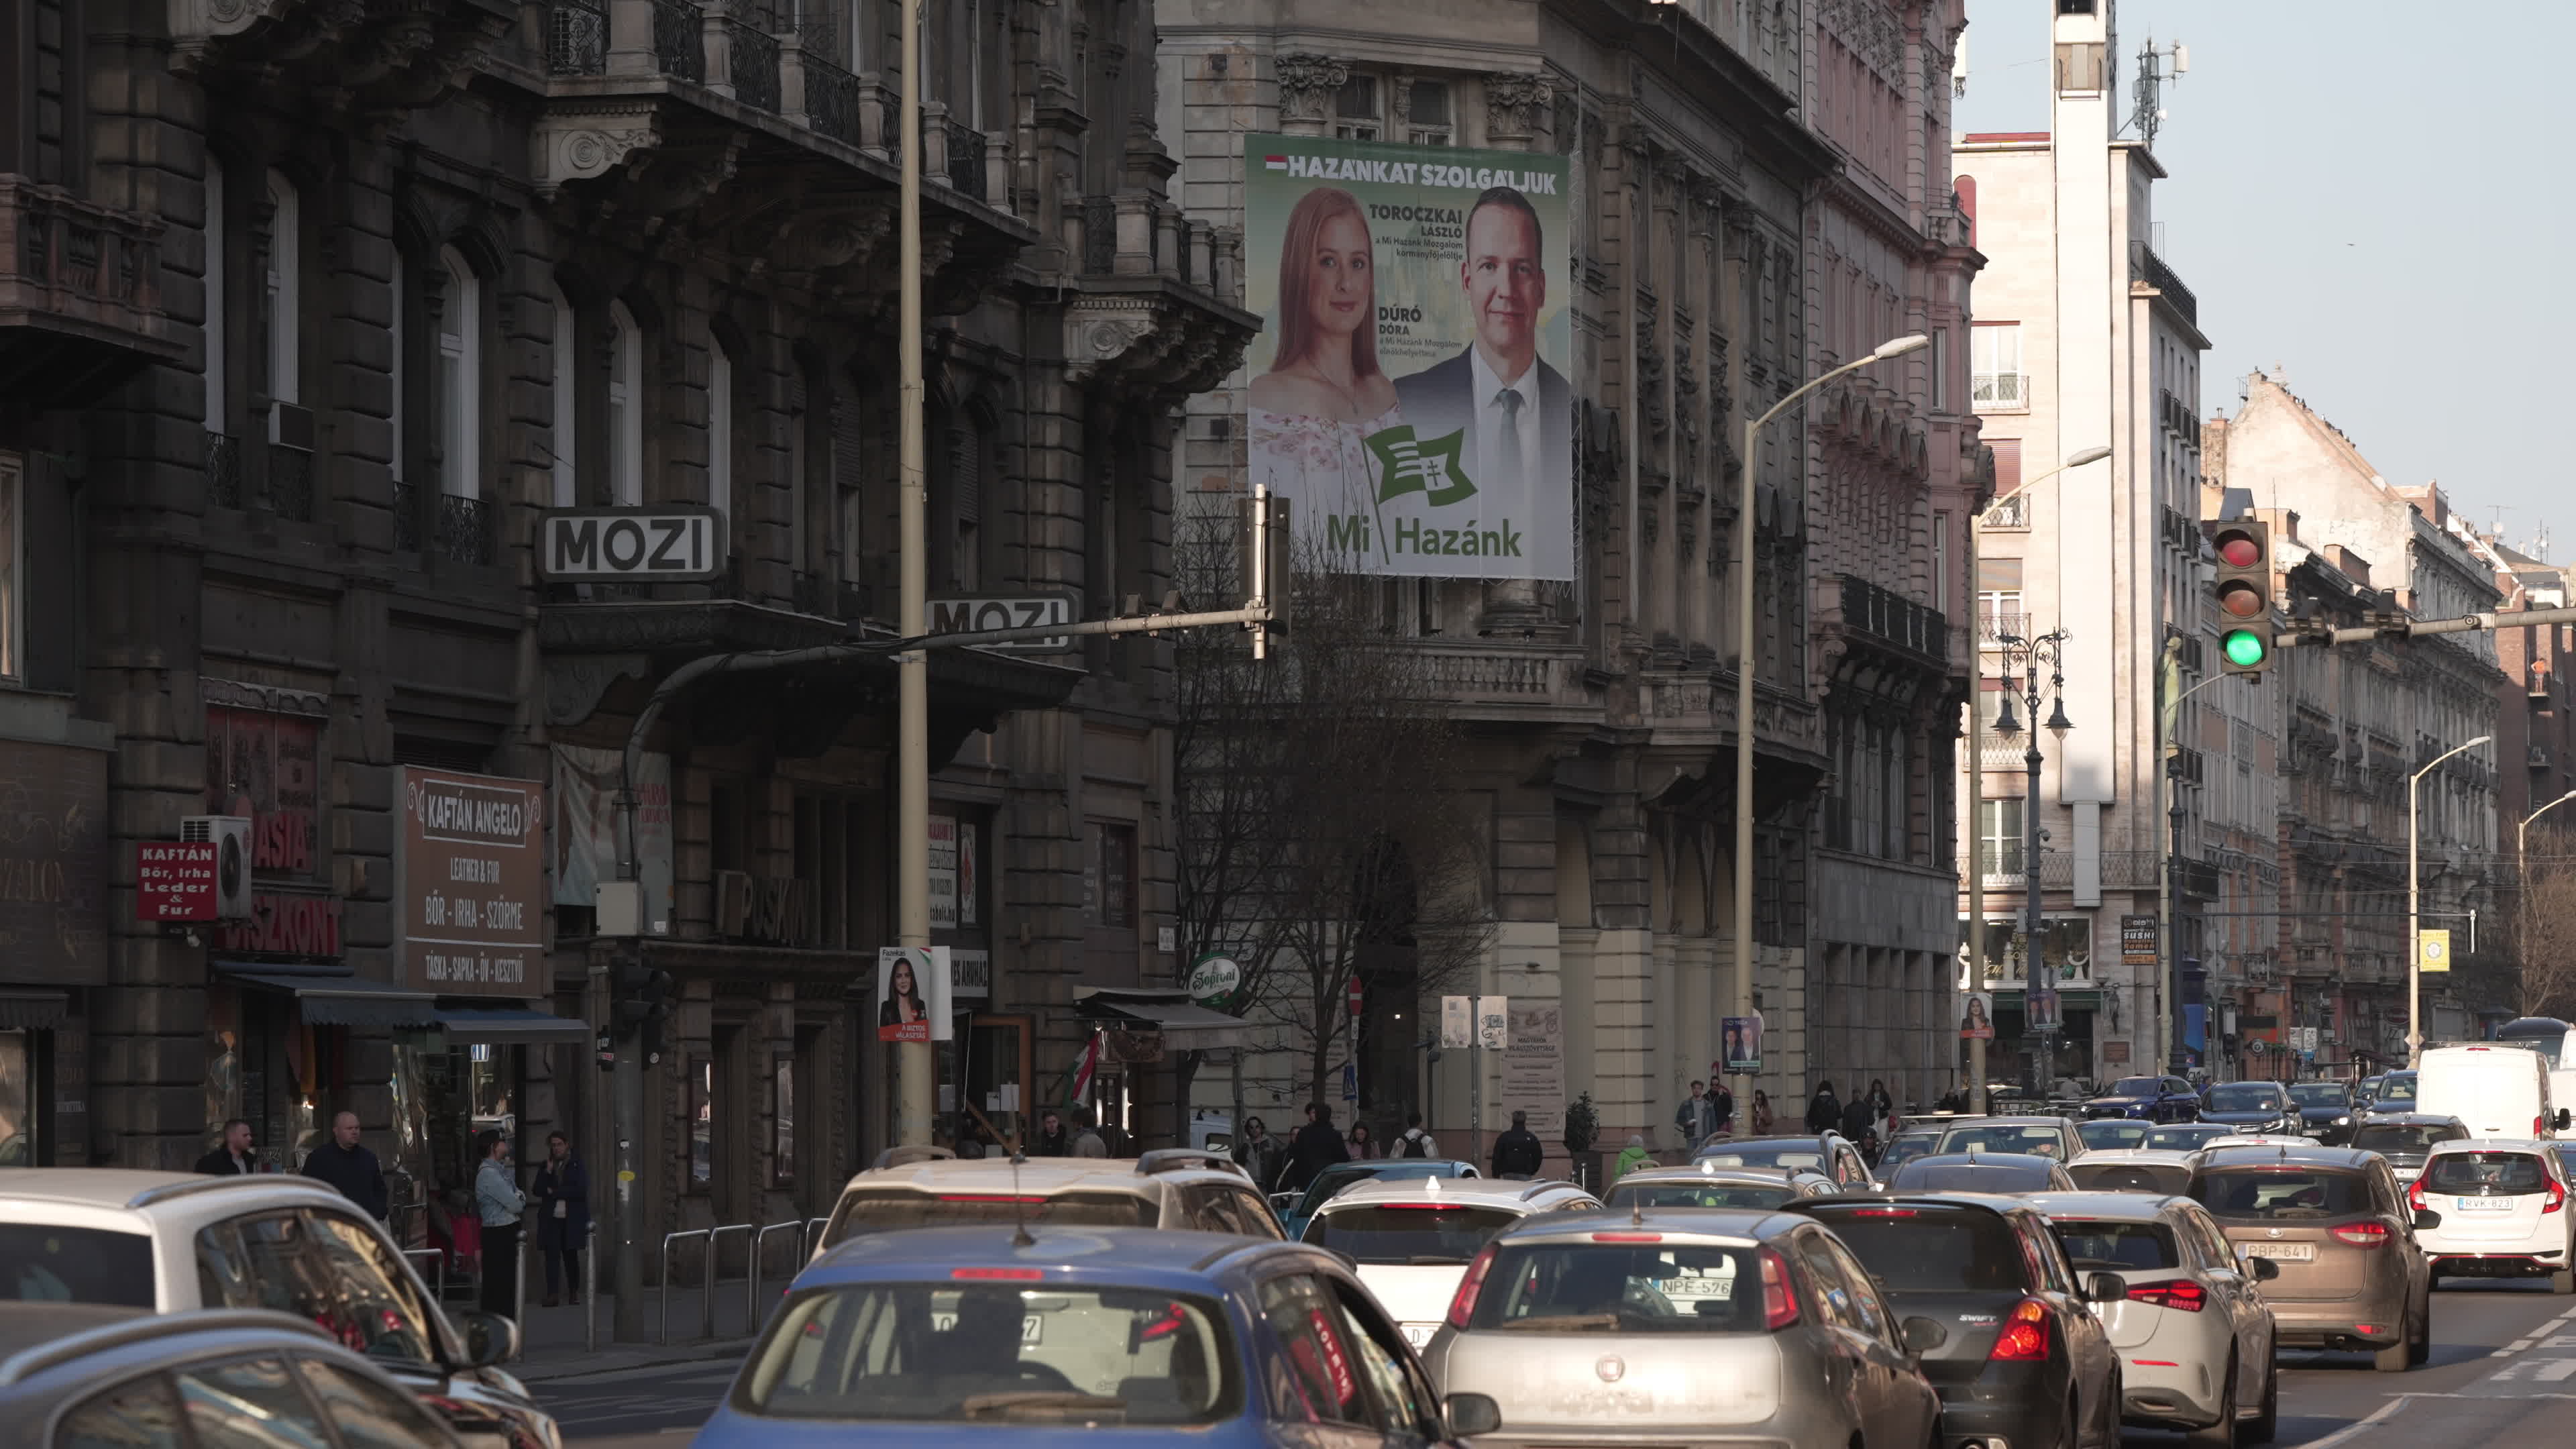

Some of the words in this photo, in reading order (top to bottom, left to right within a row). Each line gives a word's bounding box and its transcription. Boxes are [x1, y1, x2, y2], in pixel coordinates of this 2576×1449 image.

[1288, 155, 1417, 184] HAZÁNKAT
[1421, 163, 1557, 195] SZOLGÁLJUK
[1368, 204, 1462, 224] TOROCZKAI
[1421, 223, 1462, 238] LÁSZLÓ
[1382, 236, 1392, 244] Mi
[1424, 239, 1463, 250] Mozgalom
[1379, 304, 1421, 323] DÚRÓ
[1379, 323, 1409, 335] DÓRA
[1328, 515, 1369, 553] Mi
[1395, 518, 1522, 557] Hazánk
[555, 519, 702, 571] MOZI
[934, 602, 1059, 644] MOZI
[428, 790, 472, 830] KAFTÁN
[475, 800, 521, 837] ANGELO
[142, 845, 212, 861] KAFTÁN
[450, 857, 479, 882] LEATHER
[487, 861, 500, 884] FUR
[144, 882, 209, 893] Leder
[170, 894, 183, 903] &
[158, 904, 194, 915] Fur
[455, 899, 477, 928] IRHA
[425, 950, 447, 980] TÁSKA
[453, 957, 474, 982] SAPKA
[1193, 968, 1235, 990] Soproni
[2465, 1199, 2510, 1208] RVK-823
[2248, 1245, 2308, 1258] PBP-641
[1662, 1281, 1729, 1294] NPE-576
[1959, 1314, 1997, 1322] SWIFT
